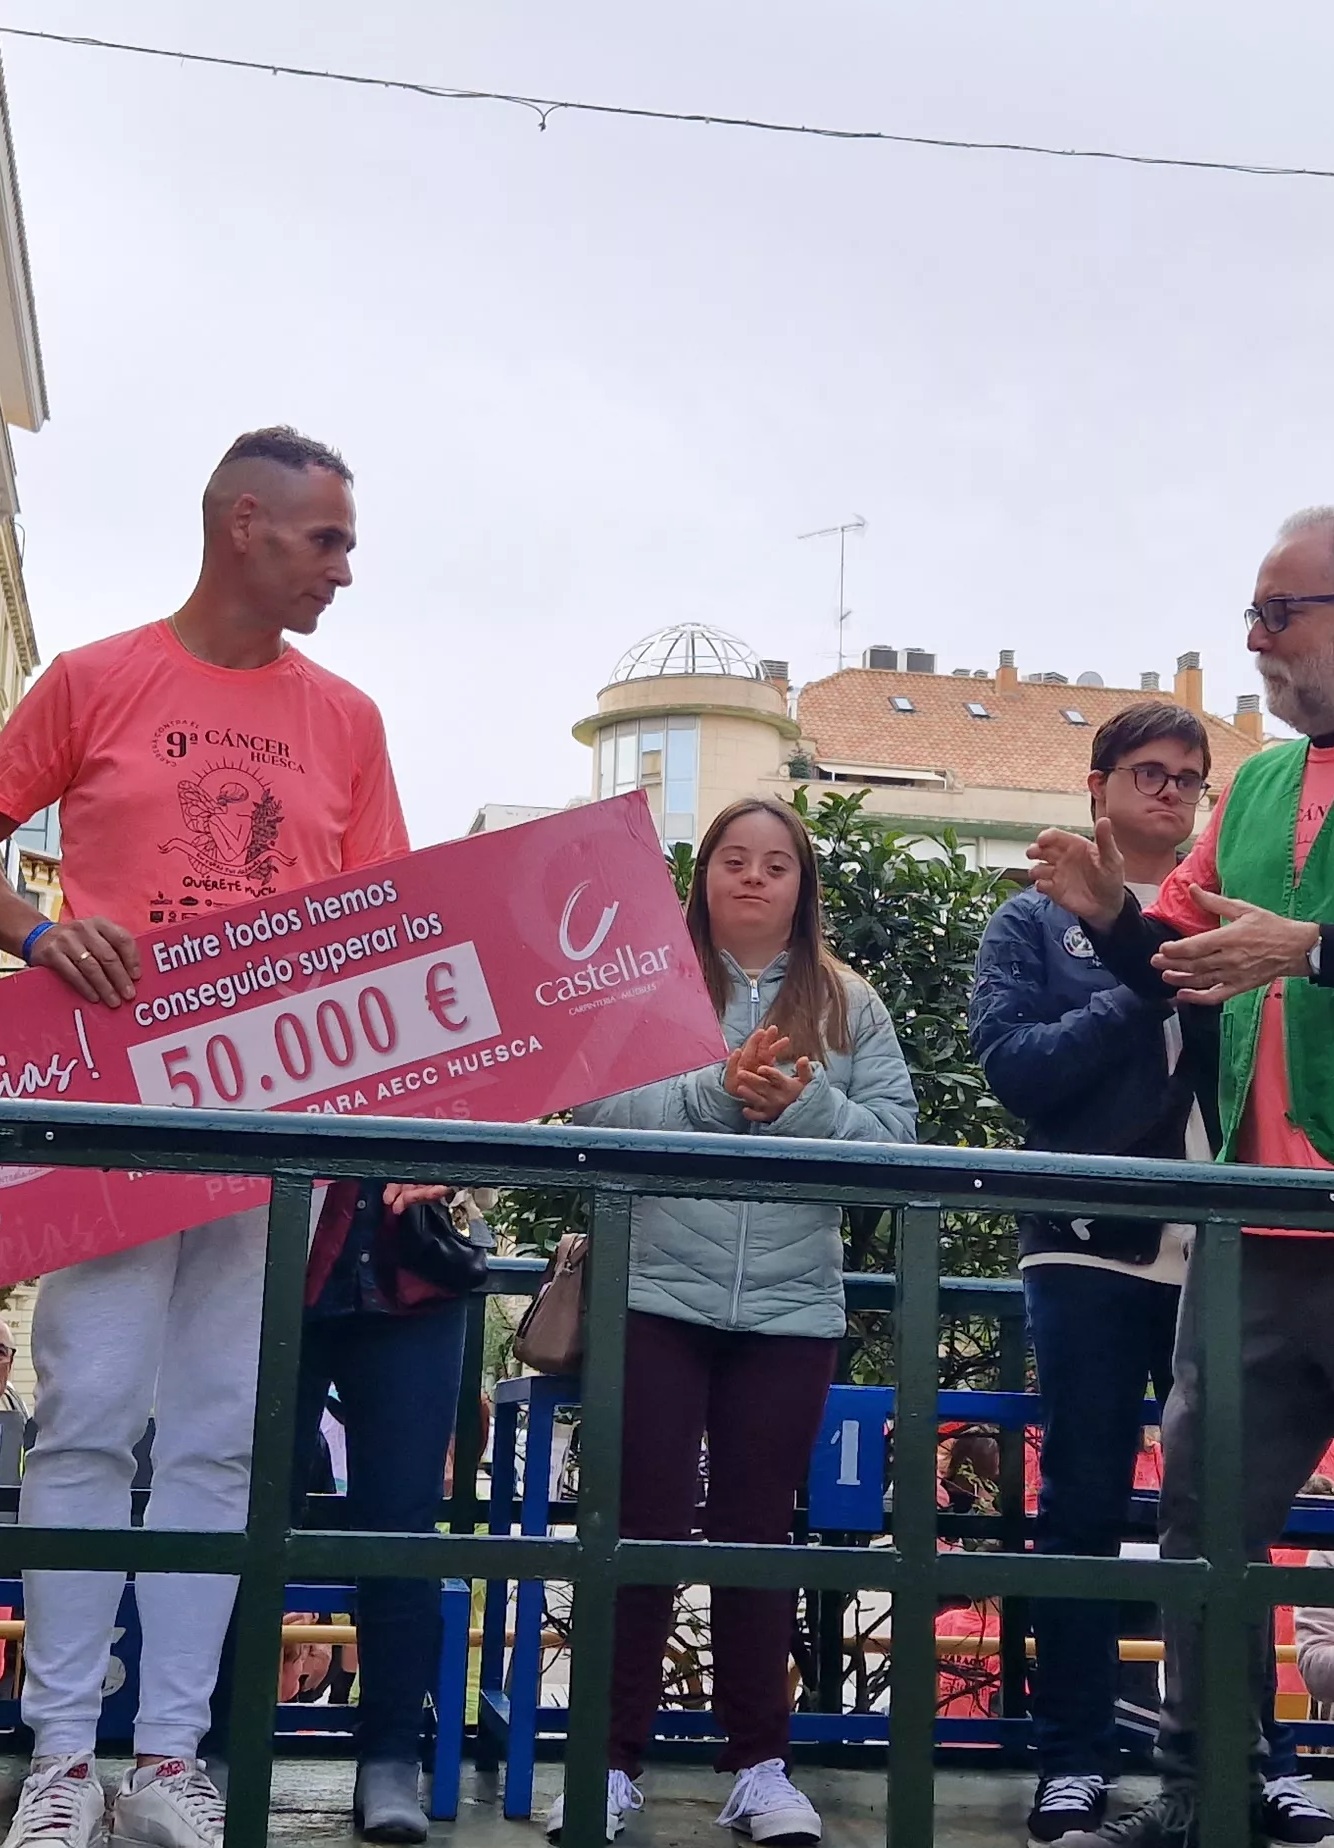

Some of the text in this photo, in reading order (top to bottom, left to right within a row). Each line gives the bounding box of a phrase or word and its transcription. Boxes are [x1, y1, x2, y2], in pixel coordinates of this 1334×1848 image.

[204, 728, 290, 758] CÁNCER
[250, 752, 306, 774] HUESCA
[182, 874, 242, 892] QUIÉRETE
[152, 879, 398, 973] Entre todos hemos
[134, 911, 444, 1027] conseguido superar los
[535, 944, 670, 1007] castellar
[161, 961, 470, 1107] 50.000 €
[377, 1066, 440, 1101] AECC
[447, 1035, 543, 1078] HUESCA
[830, 1420, 861, 1486] 1
